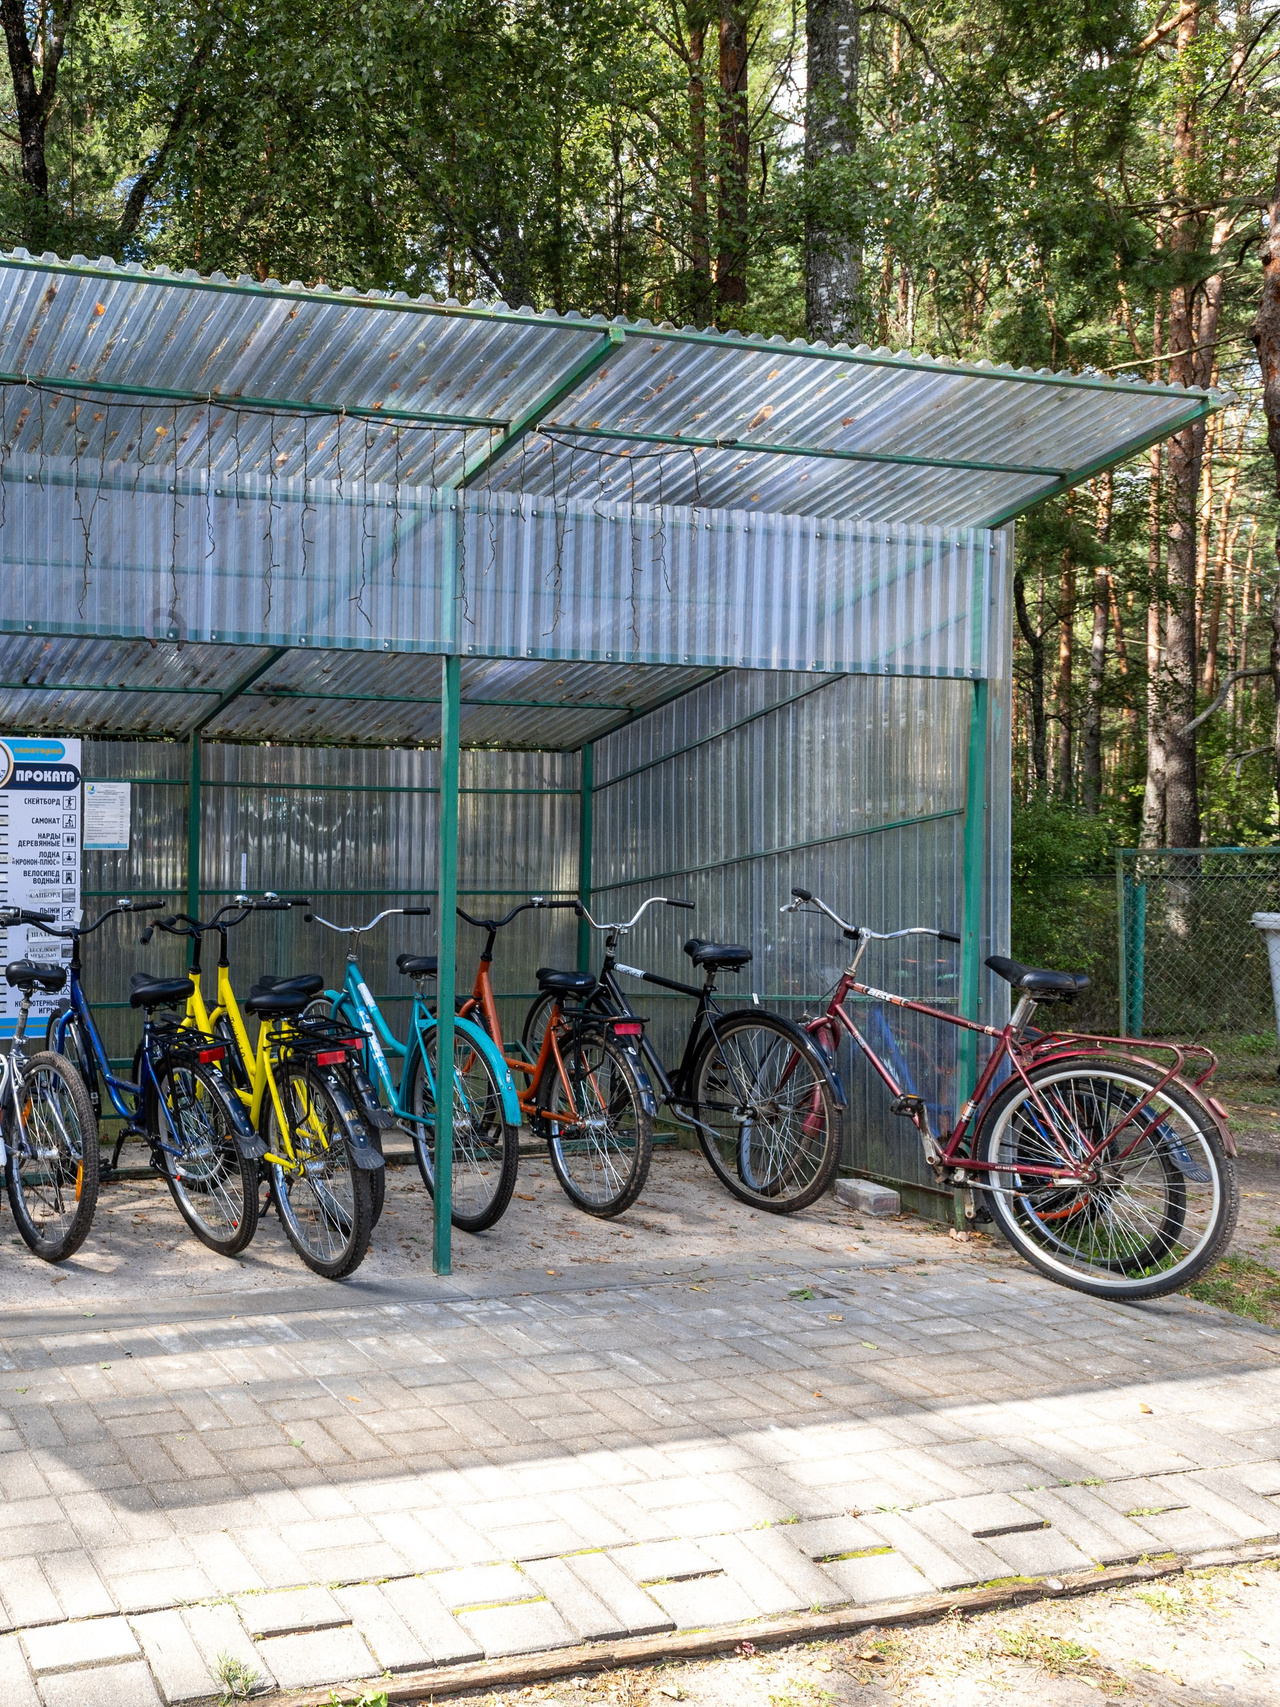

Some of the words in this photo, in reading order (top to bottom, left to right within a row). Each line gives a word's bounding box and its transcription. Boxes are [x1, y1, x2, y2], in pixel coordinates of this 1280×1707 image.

[14, 747, 63, 756] санаторий
[16, 770, 75, 782] ПРОКАТА
[24, 797, 60, 806] СКЕЙТБОРД
[212, 1068, 222, 1077] 5
[328, 1076, 338, 1084] 2
